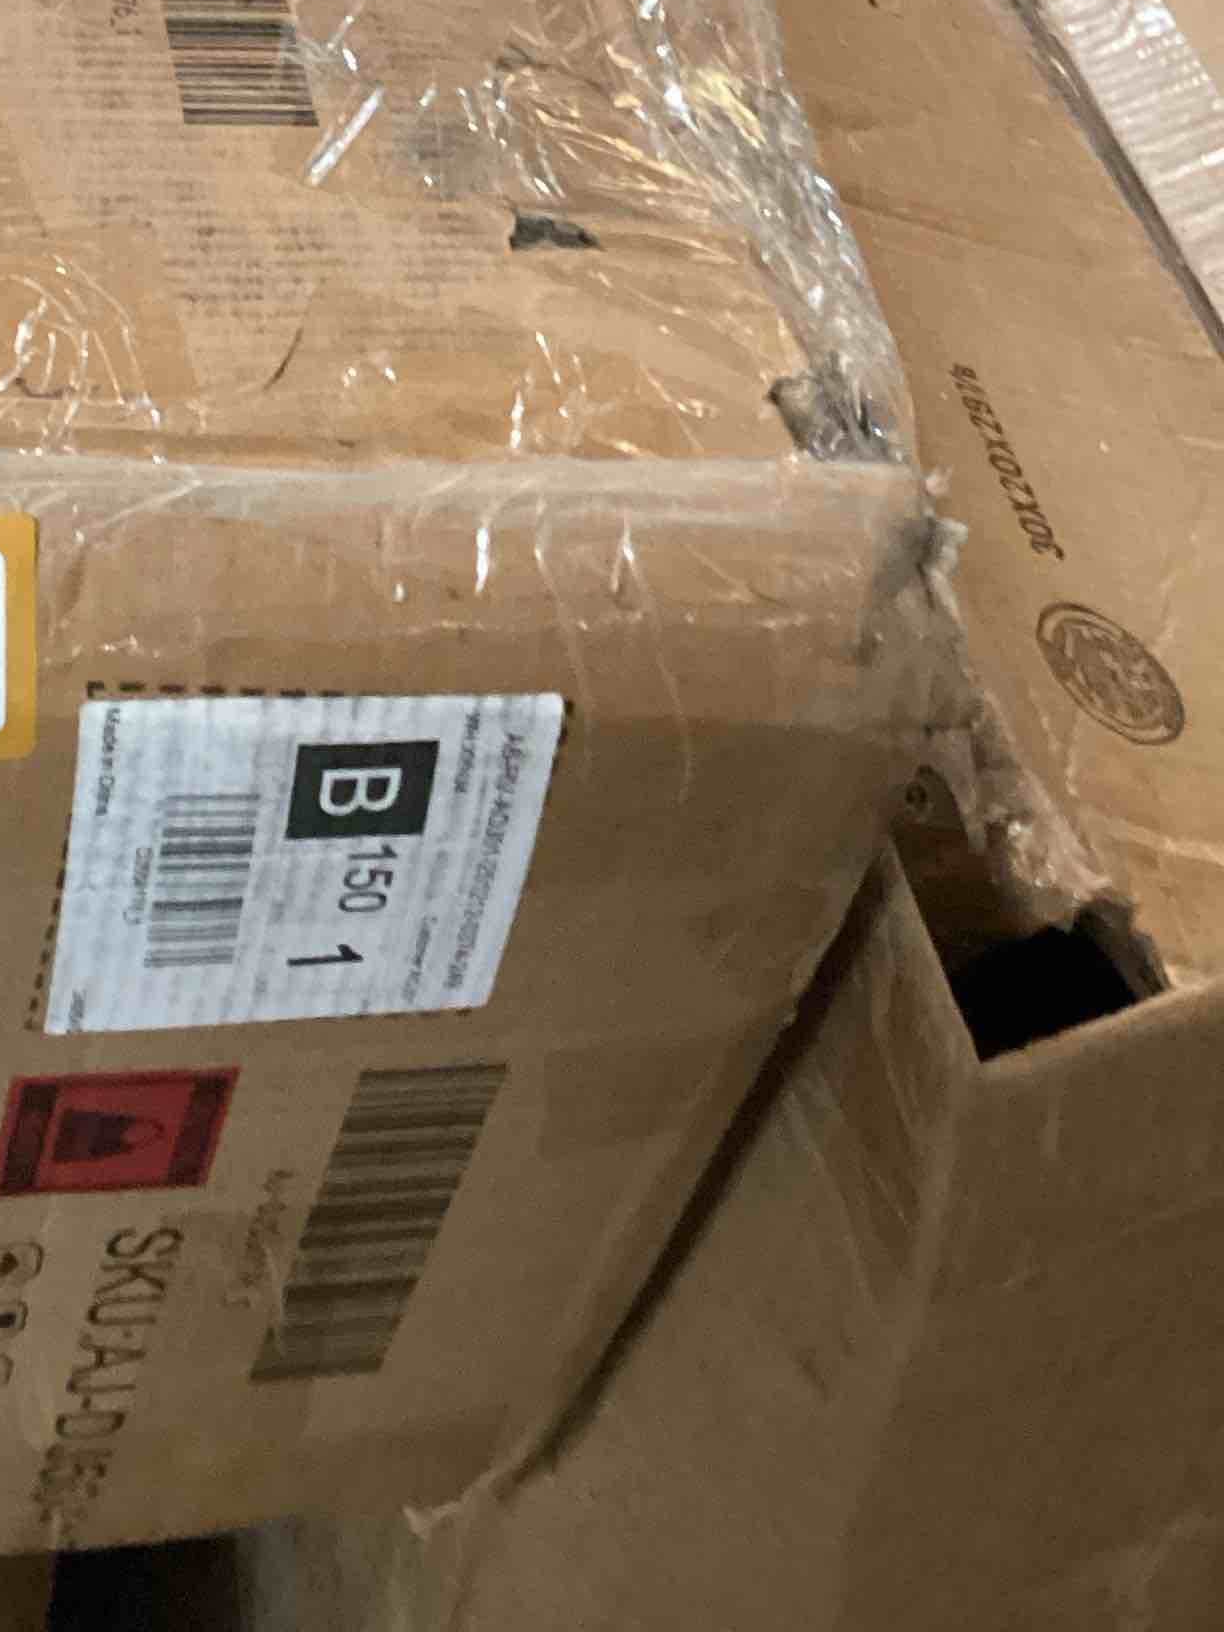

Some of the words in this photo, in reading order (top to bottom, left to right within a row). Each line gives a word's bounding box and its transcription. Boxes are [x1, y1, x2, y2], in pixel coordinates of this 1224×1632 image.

[319, 767, 403, 817] B
[338, 843, 398, 914] 150
[286, 942, 364, 968] 1
